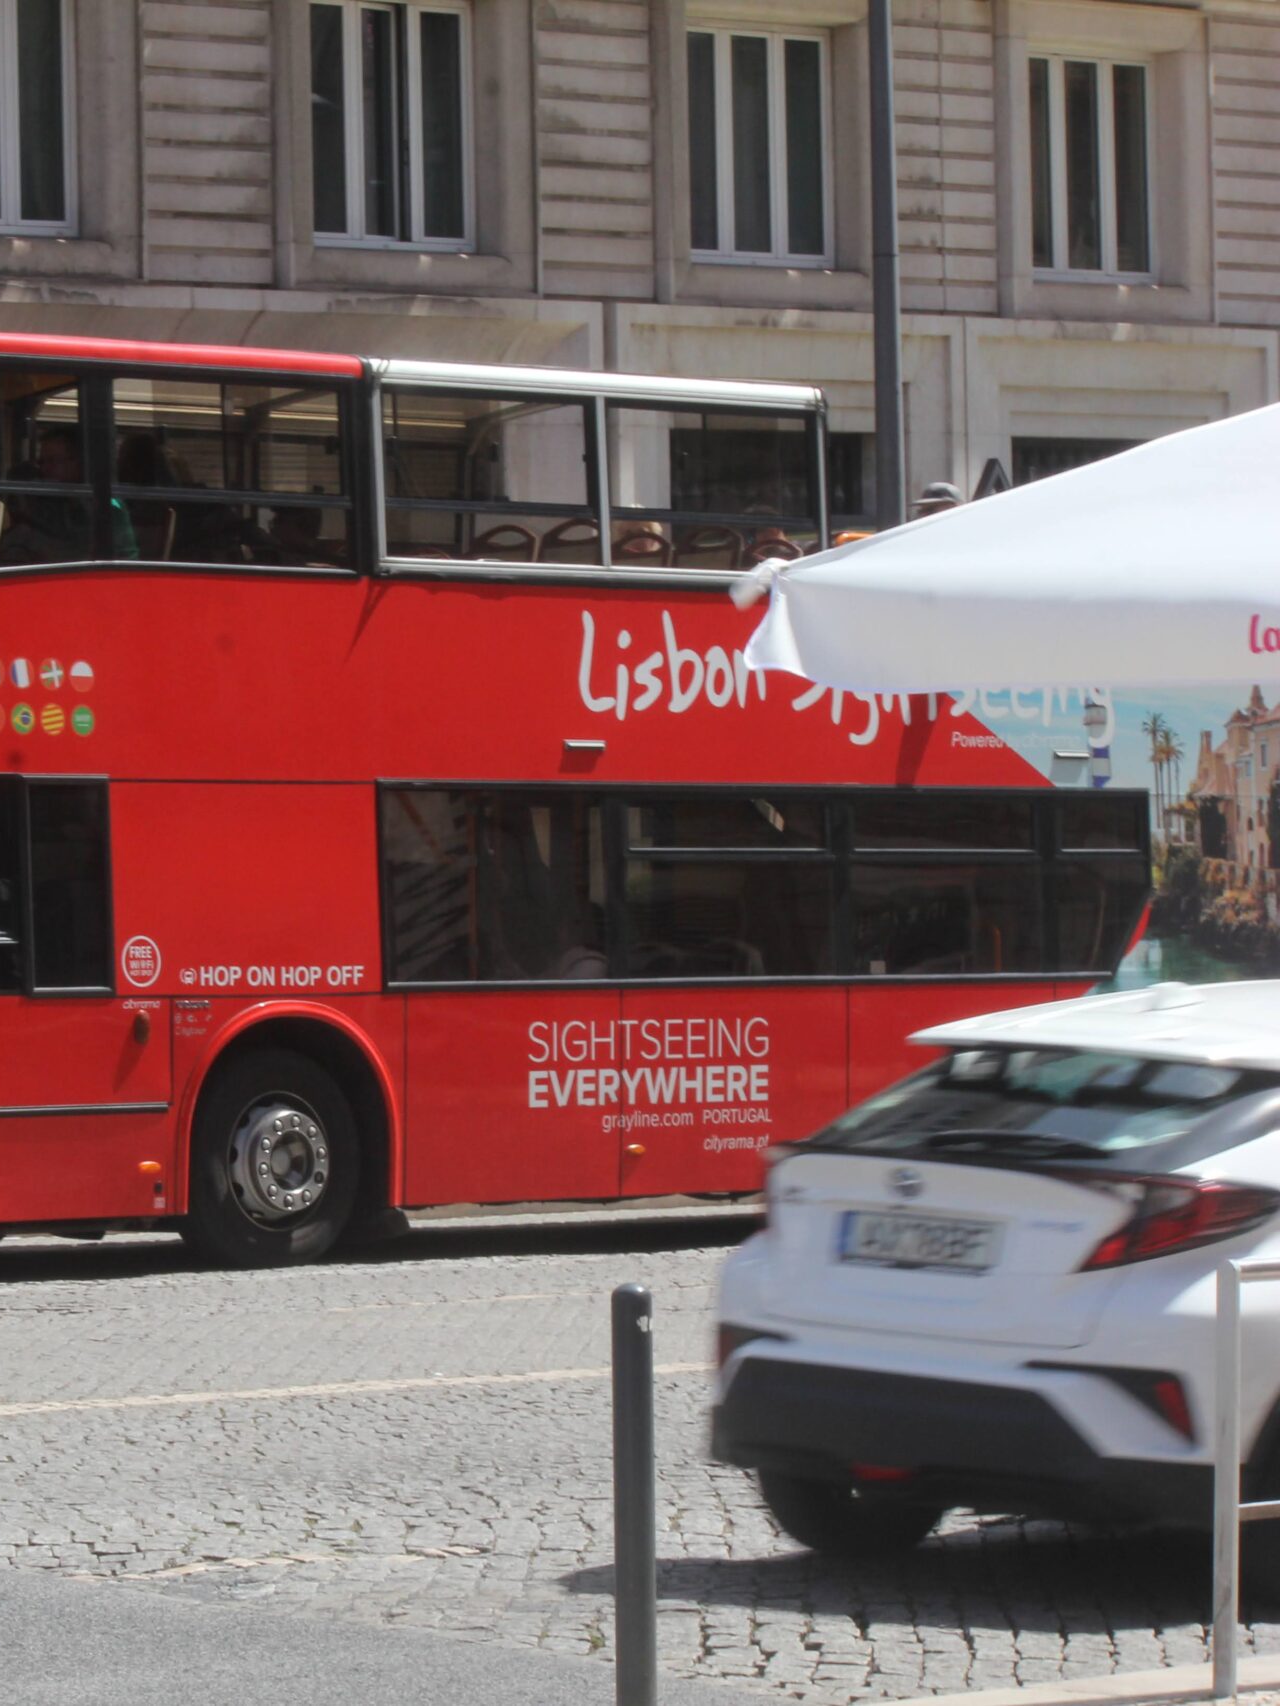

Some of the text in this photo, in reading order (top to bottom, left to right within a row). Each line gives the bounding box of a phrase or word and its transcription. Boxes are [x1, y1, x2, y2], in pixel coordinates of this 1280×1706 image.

[578, 610, 766, 721] Lisbon
[129, 945, 153, 959] FREE
[200, 965, 365, 986] HOP ON HOP OFF
[527, 1016, 770, 1063] SIGHTSEEING
[528, 1064, 769, 1108] EVERYWHERE
[602, 1108, 772, 1133] grayline.com PORTUGAL
[703, 1134, 769, 1152] cityrama.pt
